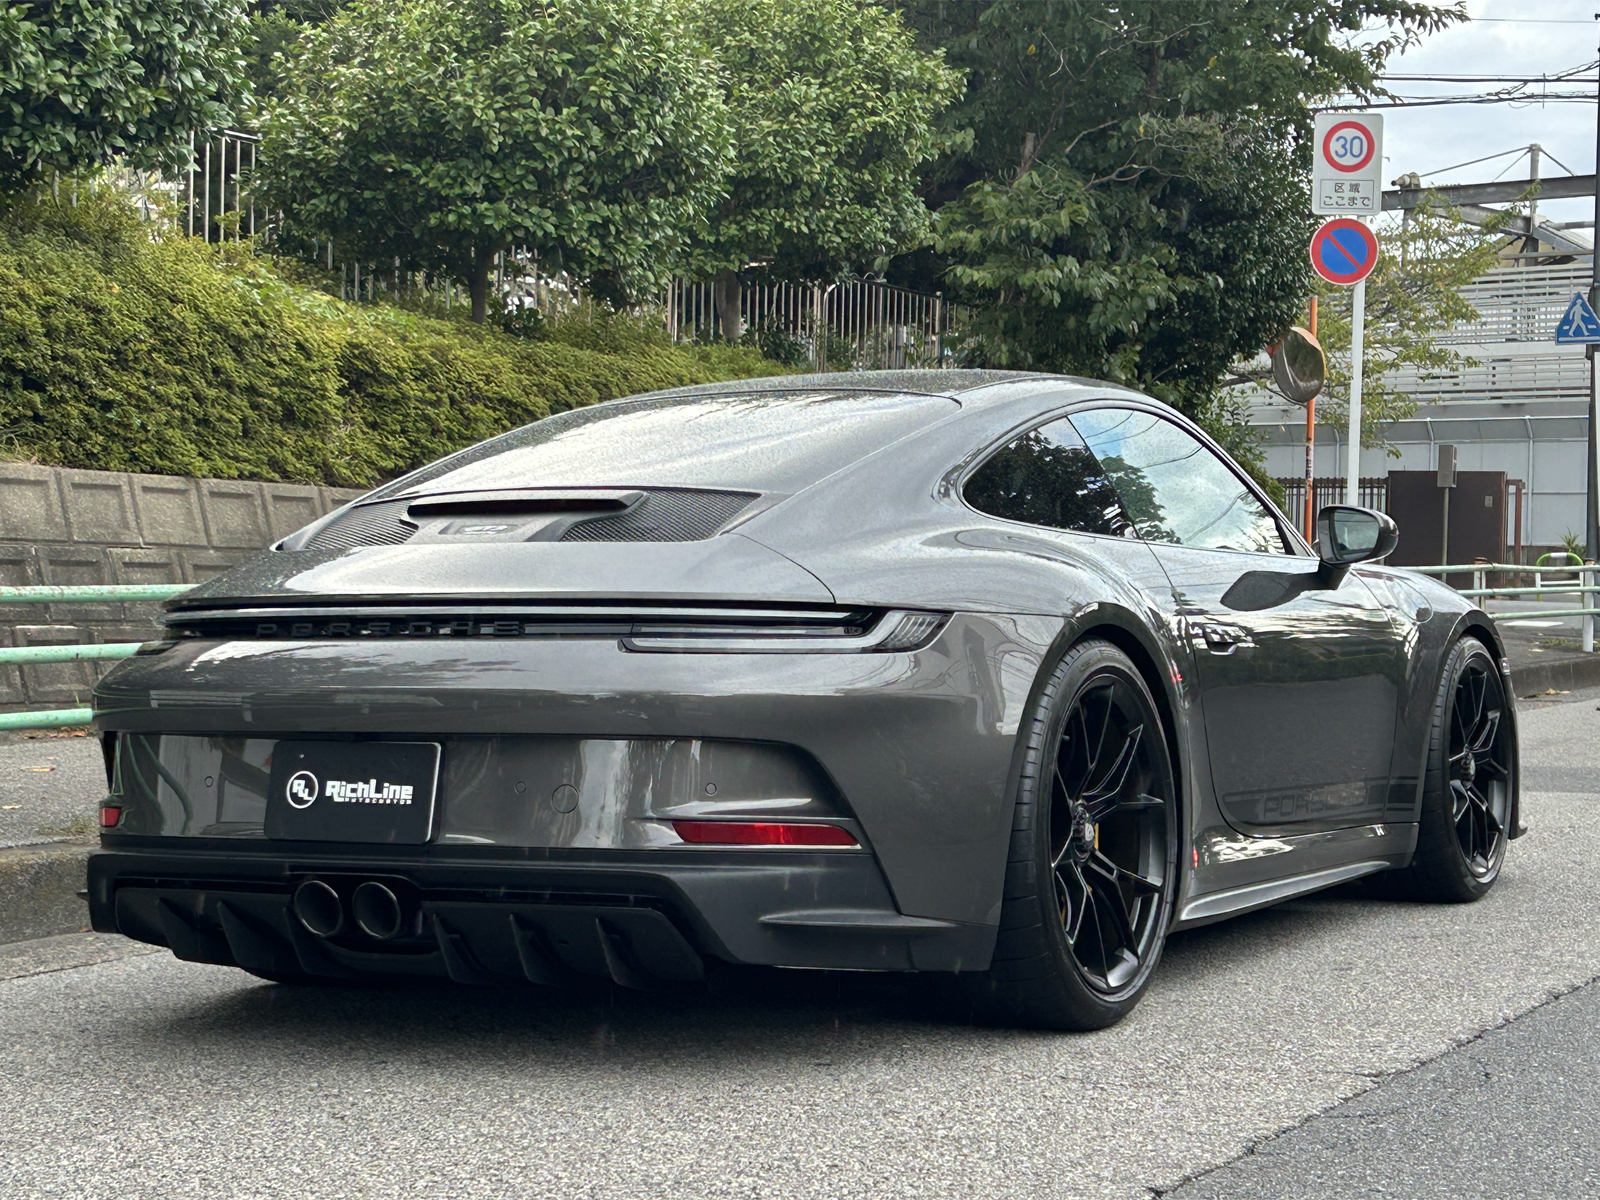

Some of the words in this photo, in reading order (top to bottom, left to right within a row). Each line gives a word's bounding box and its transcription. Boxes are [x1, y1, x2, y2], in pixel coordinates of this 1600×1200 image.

[1335, 135, 1363, 158] 30
[1335, 182, 1360, 193] 区域
[1323, 196, 1371, 207] ここまで
[256, 621, 519, 638] PORSCHE
